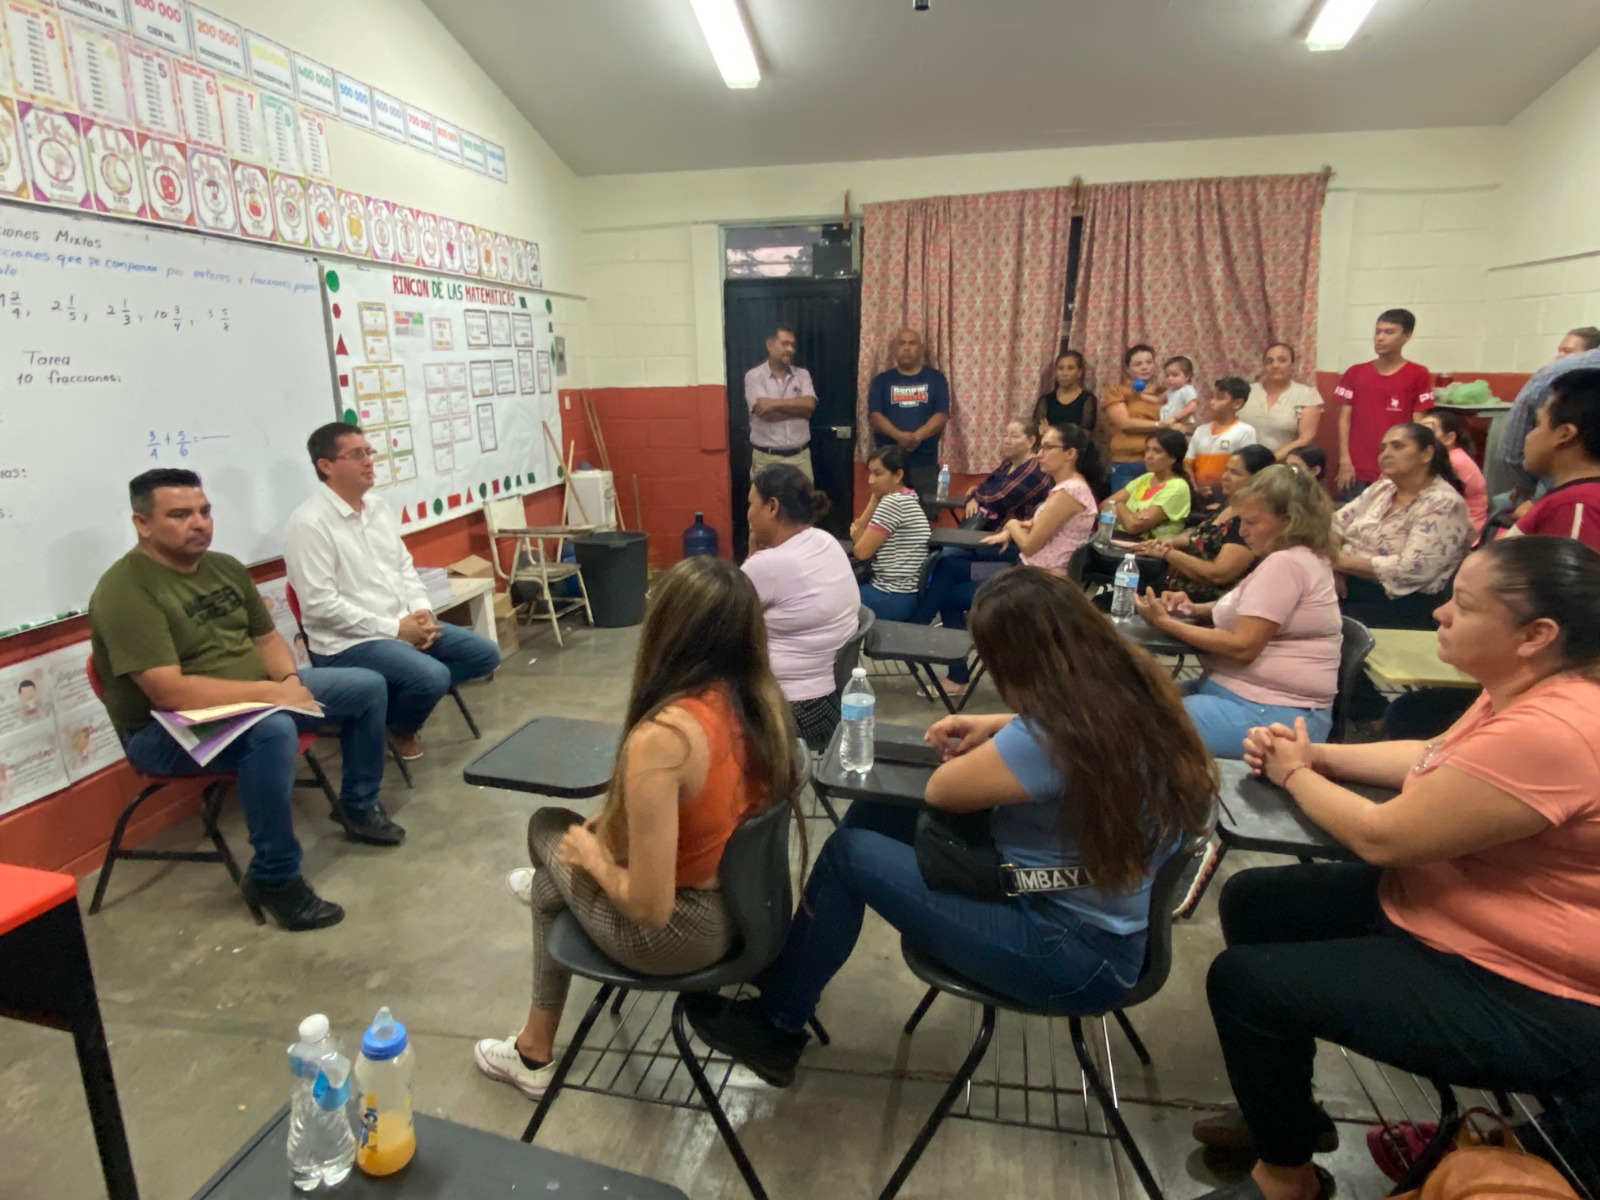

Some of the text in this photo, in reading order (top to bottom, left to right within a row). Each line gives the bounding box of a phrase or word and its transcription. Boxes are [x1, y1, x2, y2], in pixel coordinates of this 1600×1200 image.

[158, 2, 181, 22] 000
[45, 21, 55, 40] 3
[219, 29, 239, 48] 000
[157, 63, 167, 79] 5
[205, 80, 215, 95] 6
[247, 93, 254, 111] 7
[284, 112, 292, 128] 8
[317, 122, 324, 136] 9
[0, 226, 102, 249] iones Mixtas
[392, 274, 516, 307] RINCON DE LAS MATEMATICAS
[22, 350, 71, 367] Tarea
[17, 369, 123, 385] 10 fracciones:
